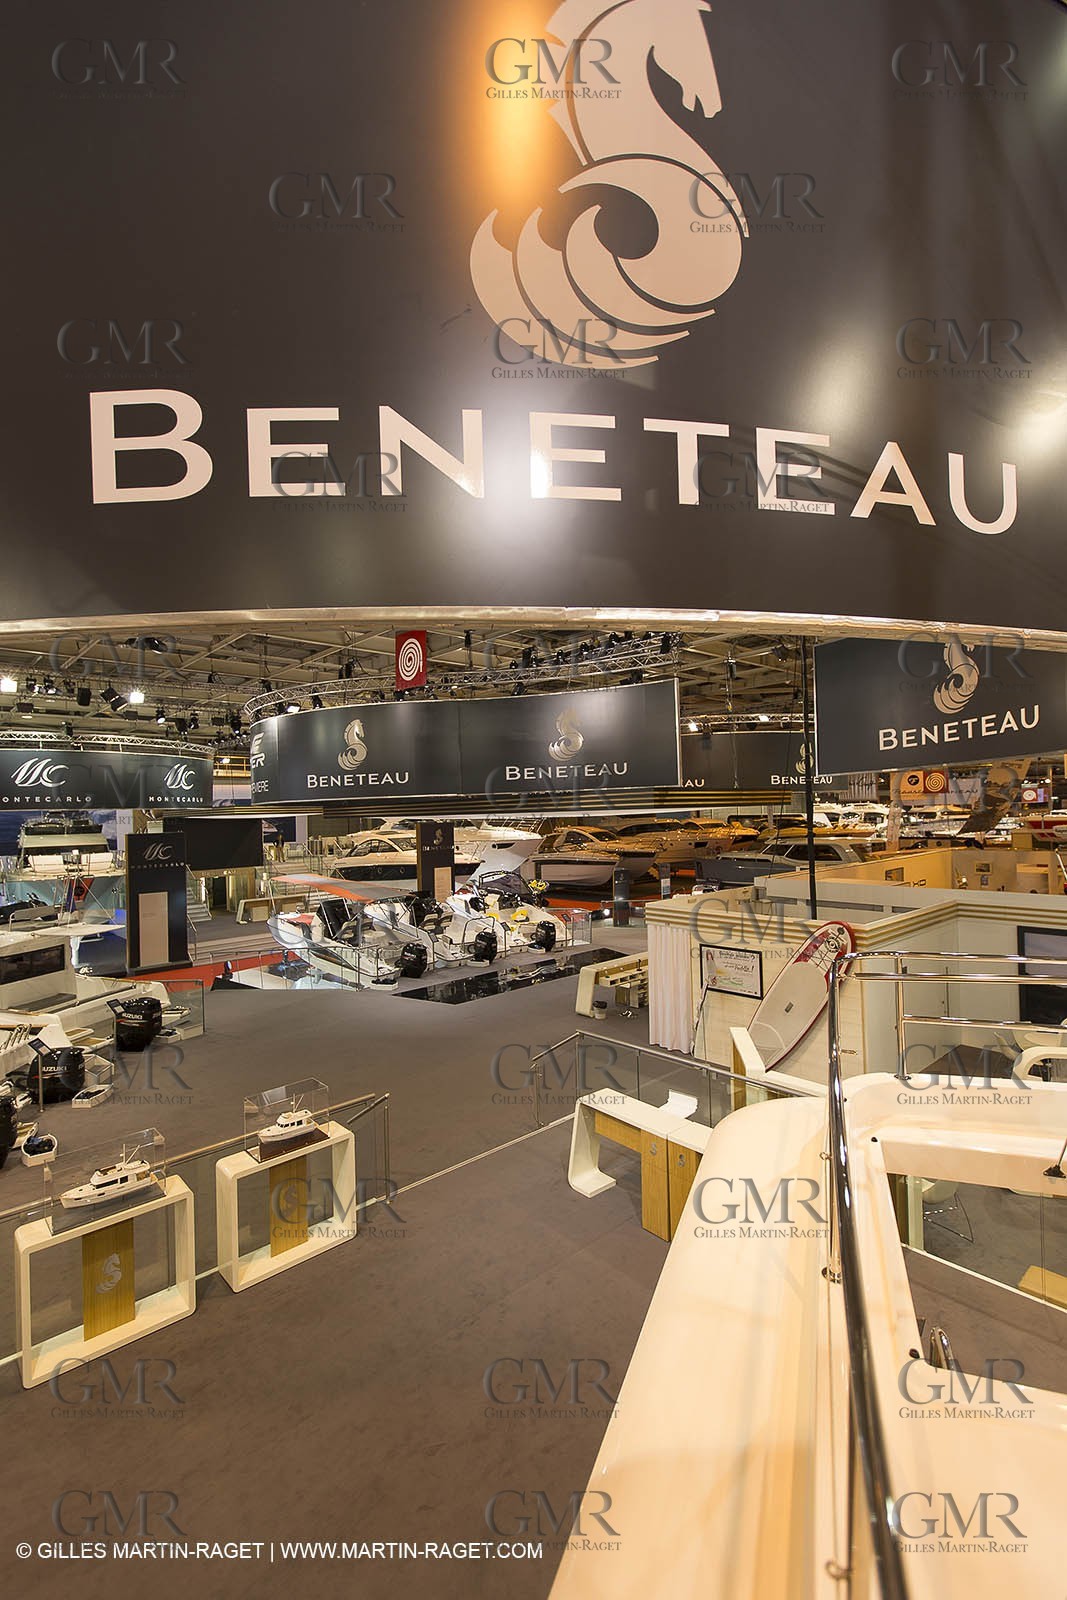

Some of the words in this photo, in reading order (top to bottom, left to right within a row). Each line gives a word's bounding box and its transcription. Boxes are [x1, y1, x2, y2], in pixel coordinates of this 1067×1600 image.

[89, 388, 1017, 535] BENETEAU
[878, 704, 1041, 751] BENETEAU
[307, 771, 409, 788] BENETEAU
[505, 762, 628, 781] BENETEAU
[771, 774, 833, 785] BENEEAU
